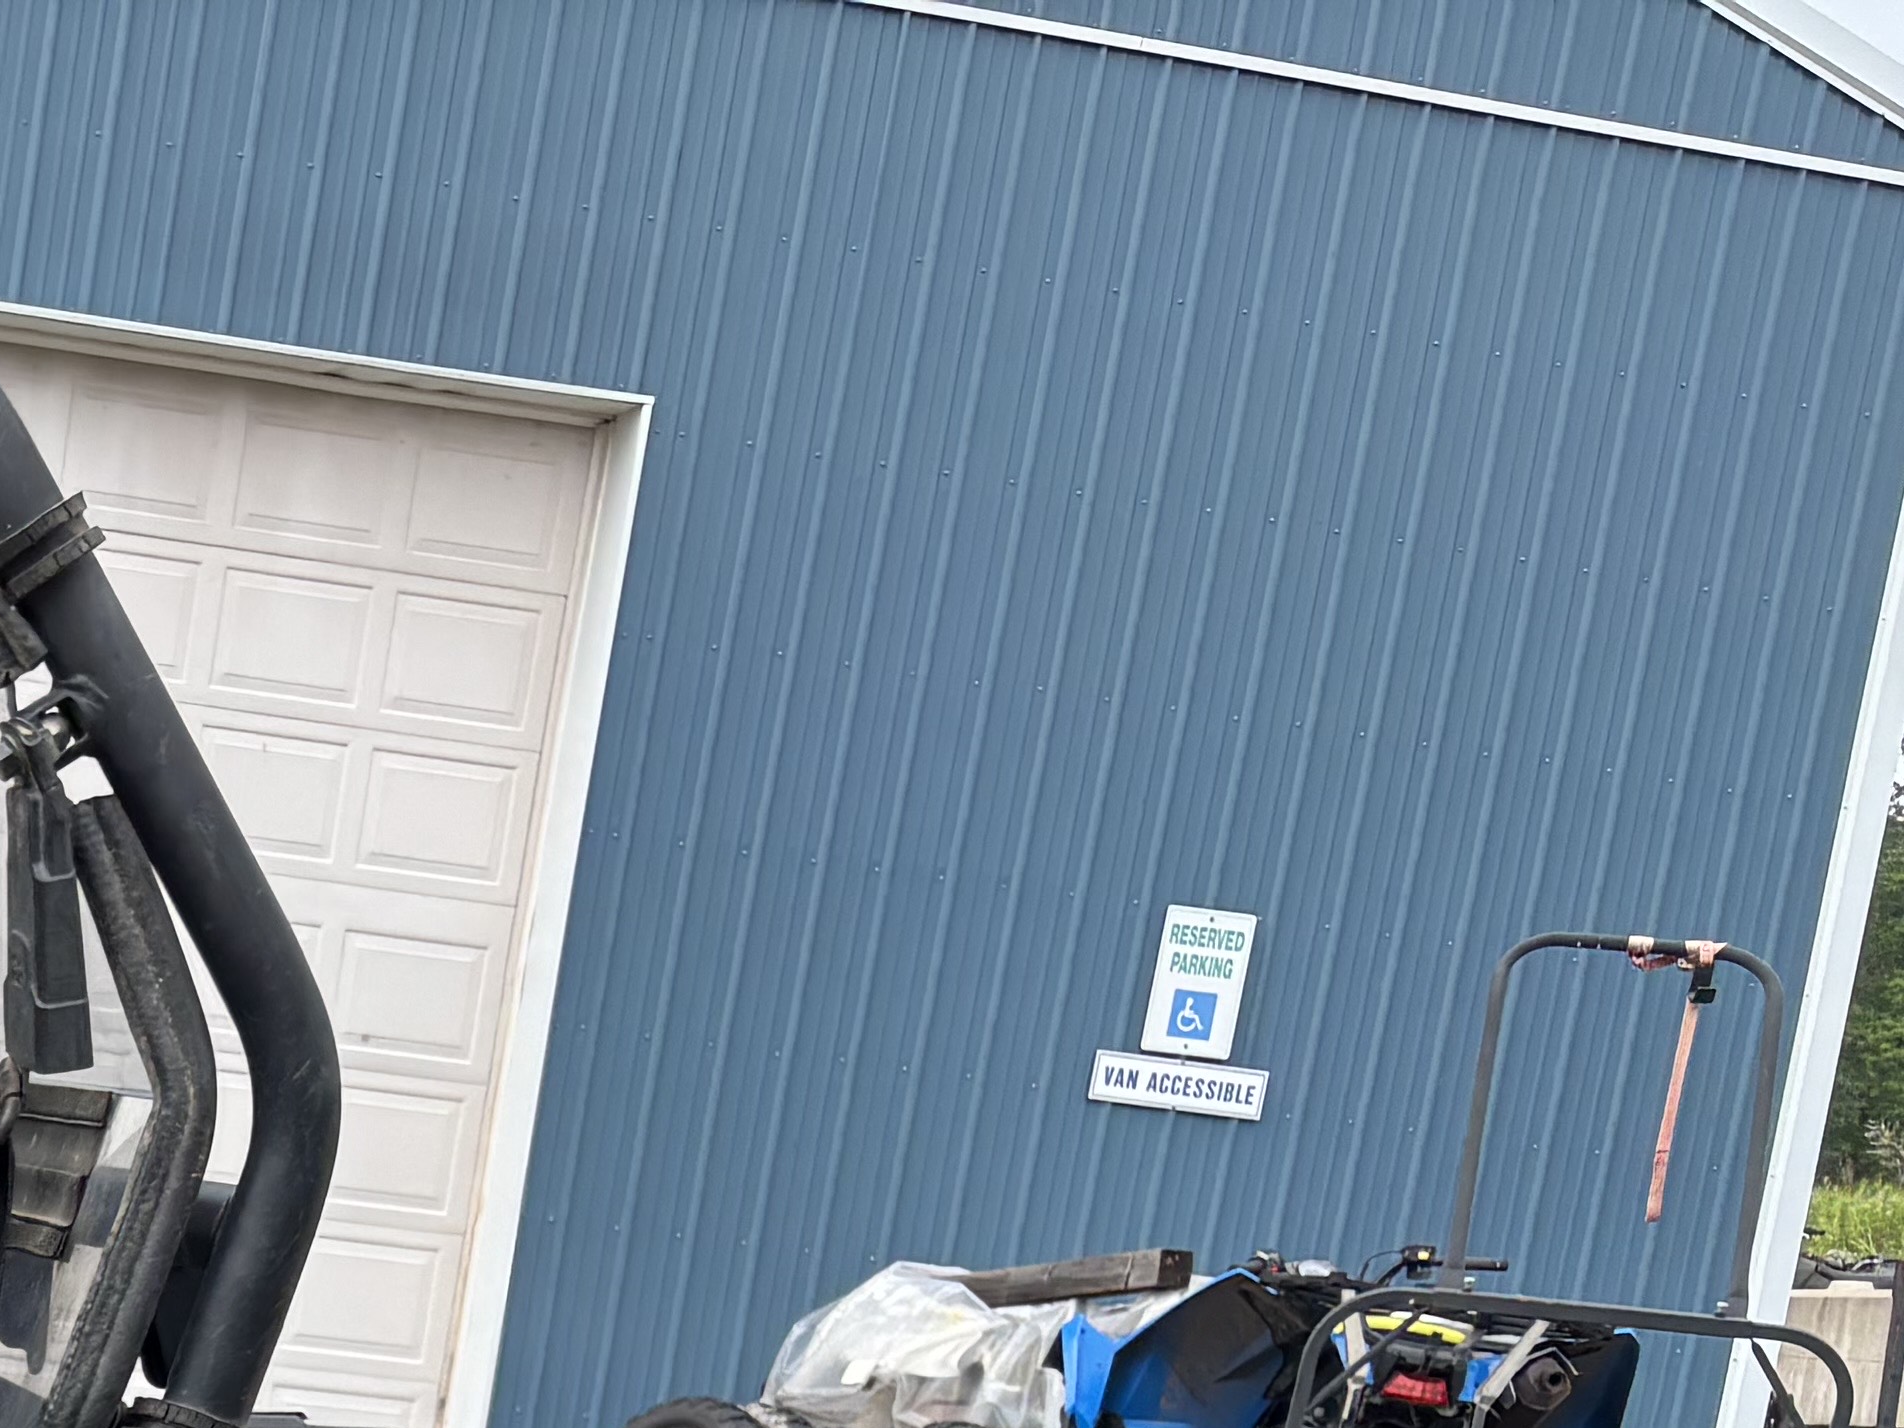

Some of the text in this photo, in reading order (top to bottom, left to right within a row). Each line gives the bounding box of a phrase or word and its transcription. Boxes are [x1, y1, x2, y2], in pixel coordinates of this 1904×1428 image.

[1169, 923, 1245, 952] RESERVED
[1170, 952, 1233, 980] PARKING
[1104, 1065, 1256, 1105] VAN ACCESSIBLE
